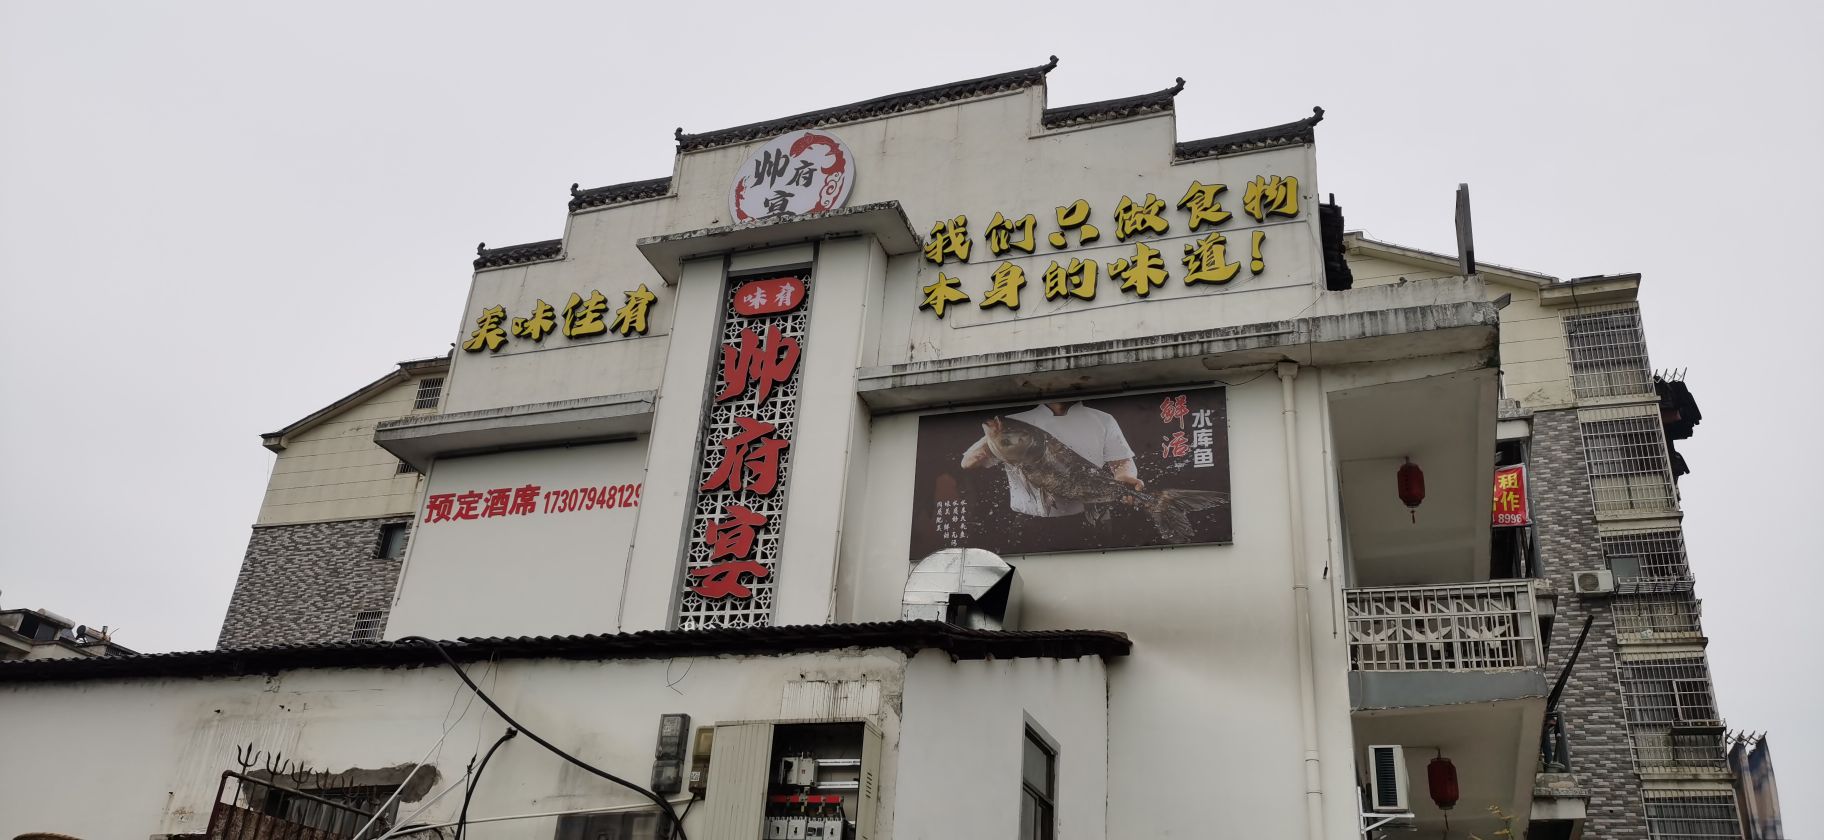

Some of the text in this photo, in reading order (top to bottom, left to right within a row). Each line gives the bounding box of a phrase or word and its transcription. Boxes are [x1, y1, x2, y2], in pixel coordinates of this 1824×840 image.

[924, 174, 1301, 266] 我们只做食物
[462, 283, 658, 353] 美味佳肴
[1160, 395, 1190, 459] 鲜活
[1190, 409, 1215, 468] 水库鱼
[690, 324, 801, 600] 帅府宴
[1493, 472, 1519, 490] 租
[424, 484, 541, 524] 预定酒席
